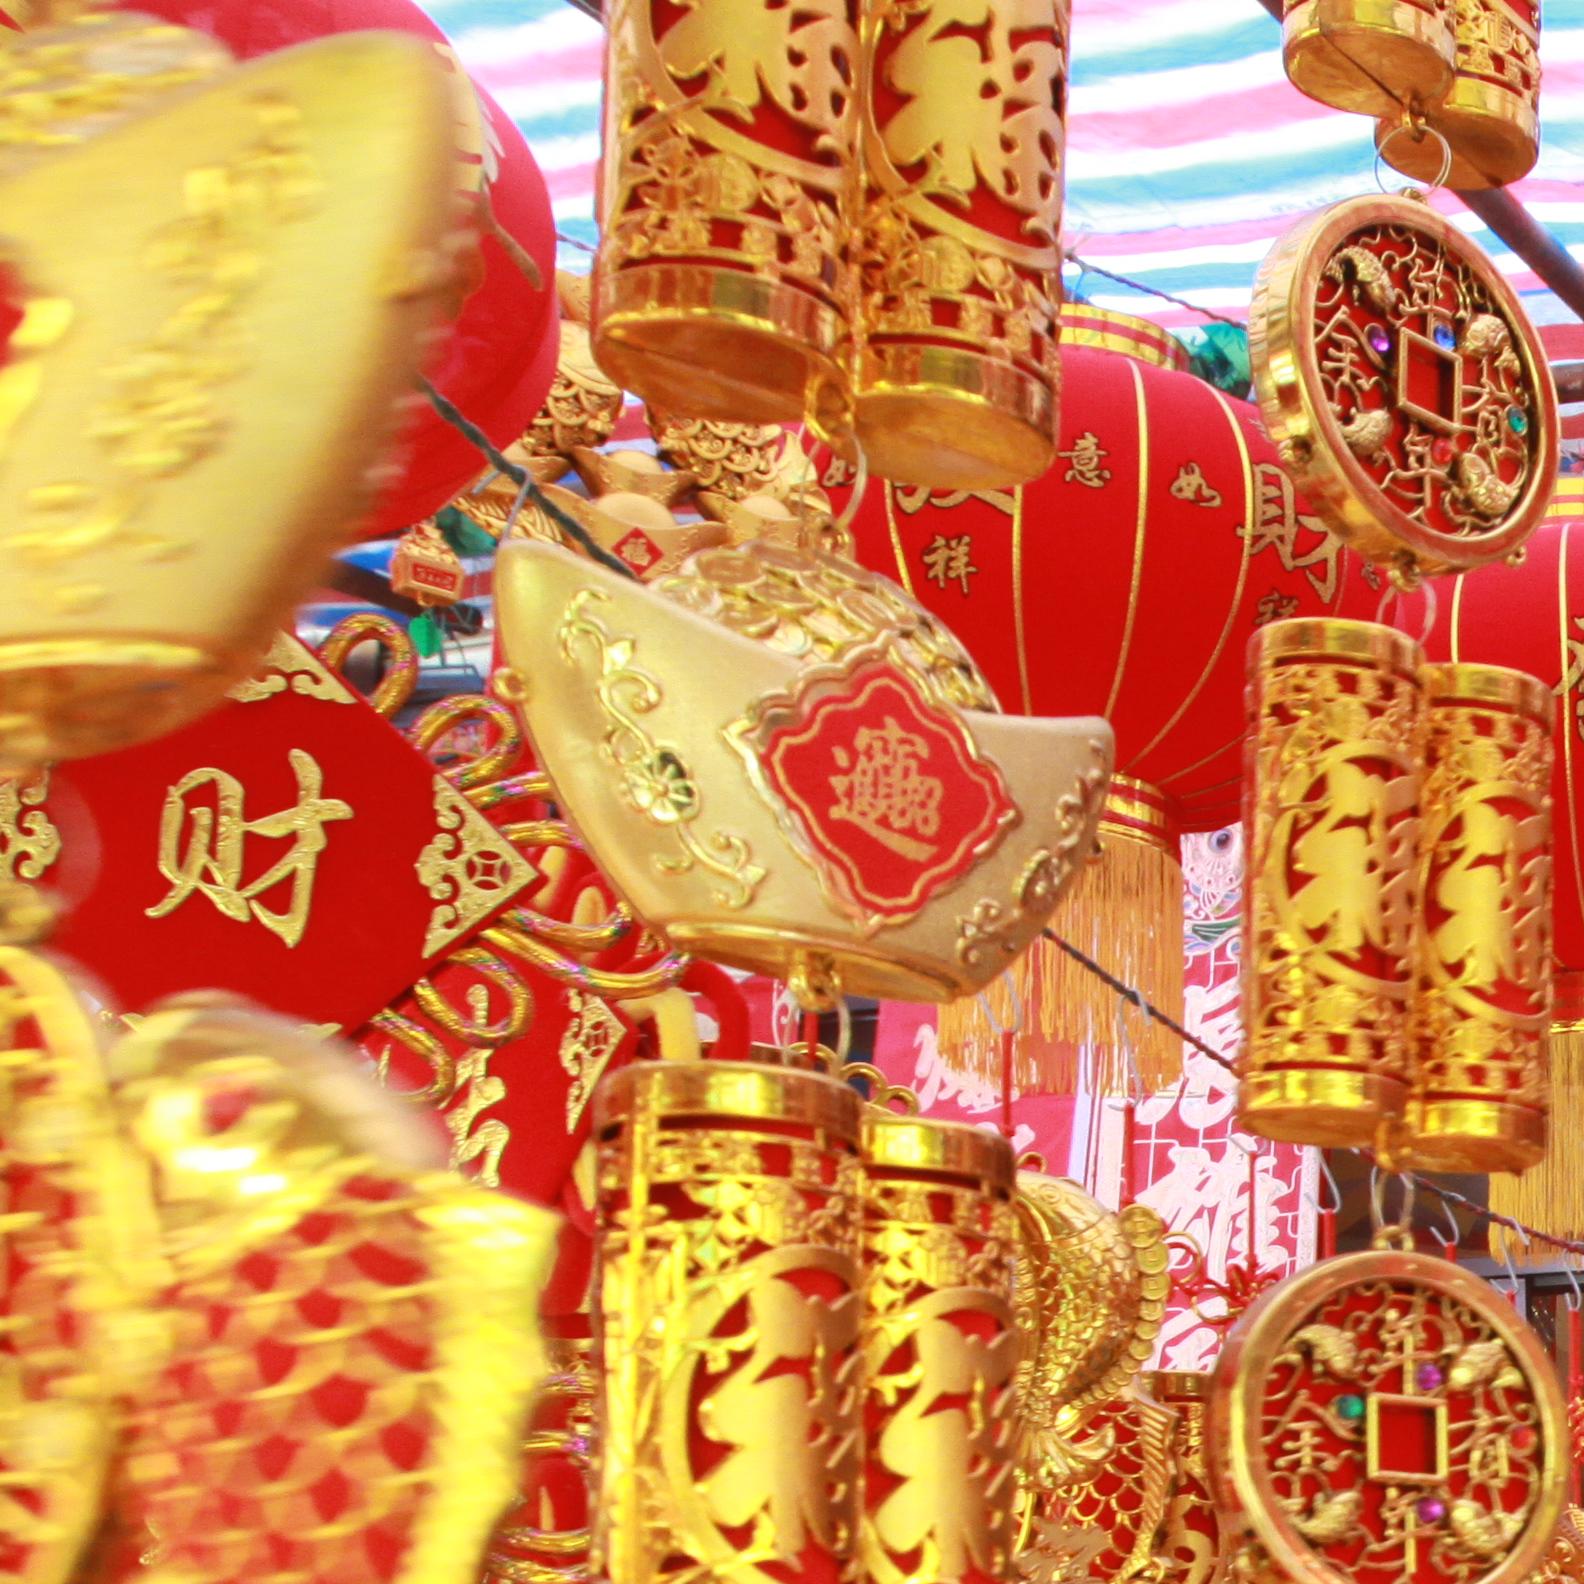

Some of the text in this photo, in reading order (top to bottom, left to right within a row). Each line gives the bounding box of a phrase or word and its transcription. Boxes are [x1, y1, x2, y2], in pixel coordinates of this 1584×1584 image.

[1057, 431, 1108, 489] 意
[923, 534, 978, 594] 祥
[145, 748, 355, 949] 财
